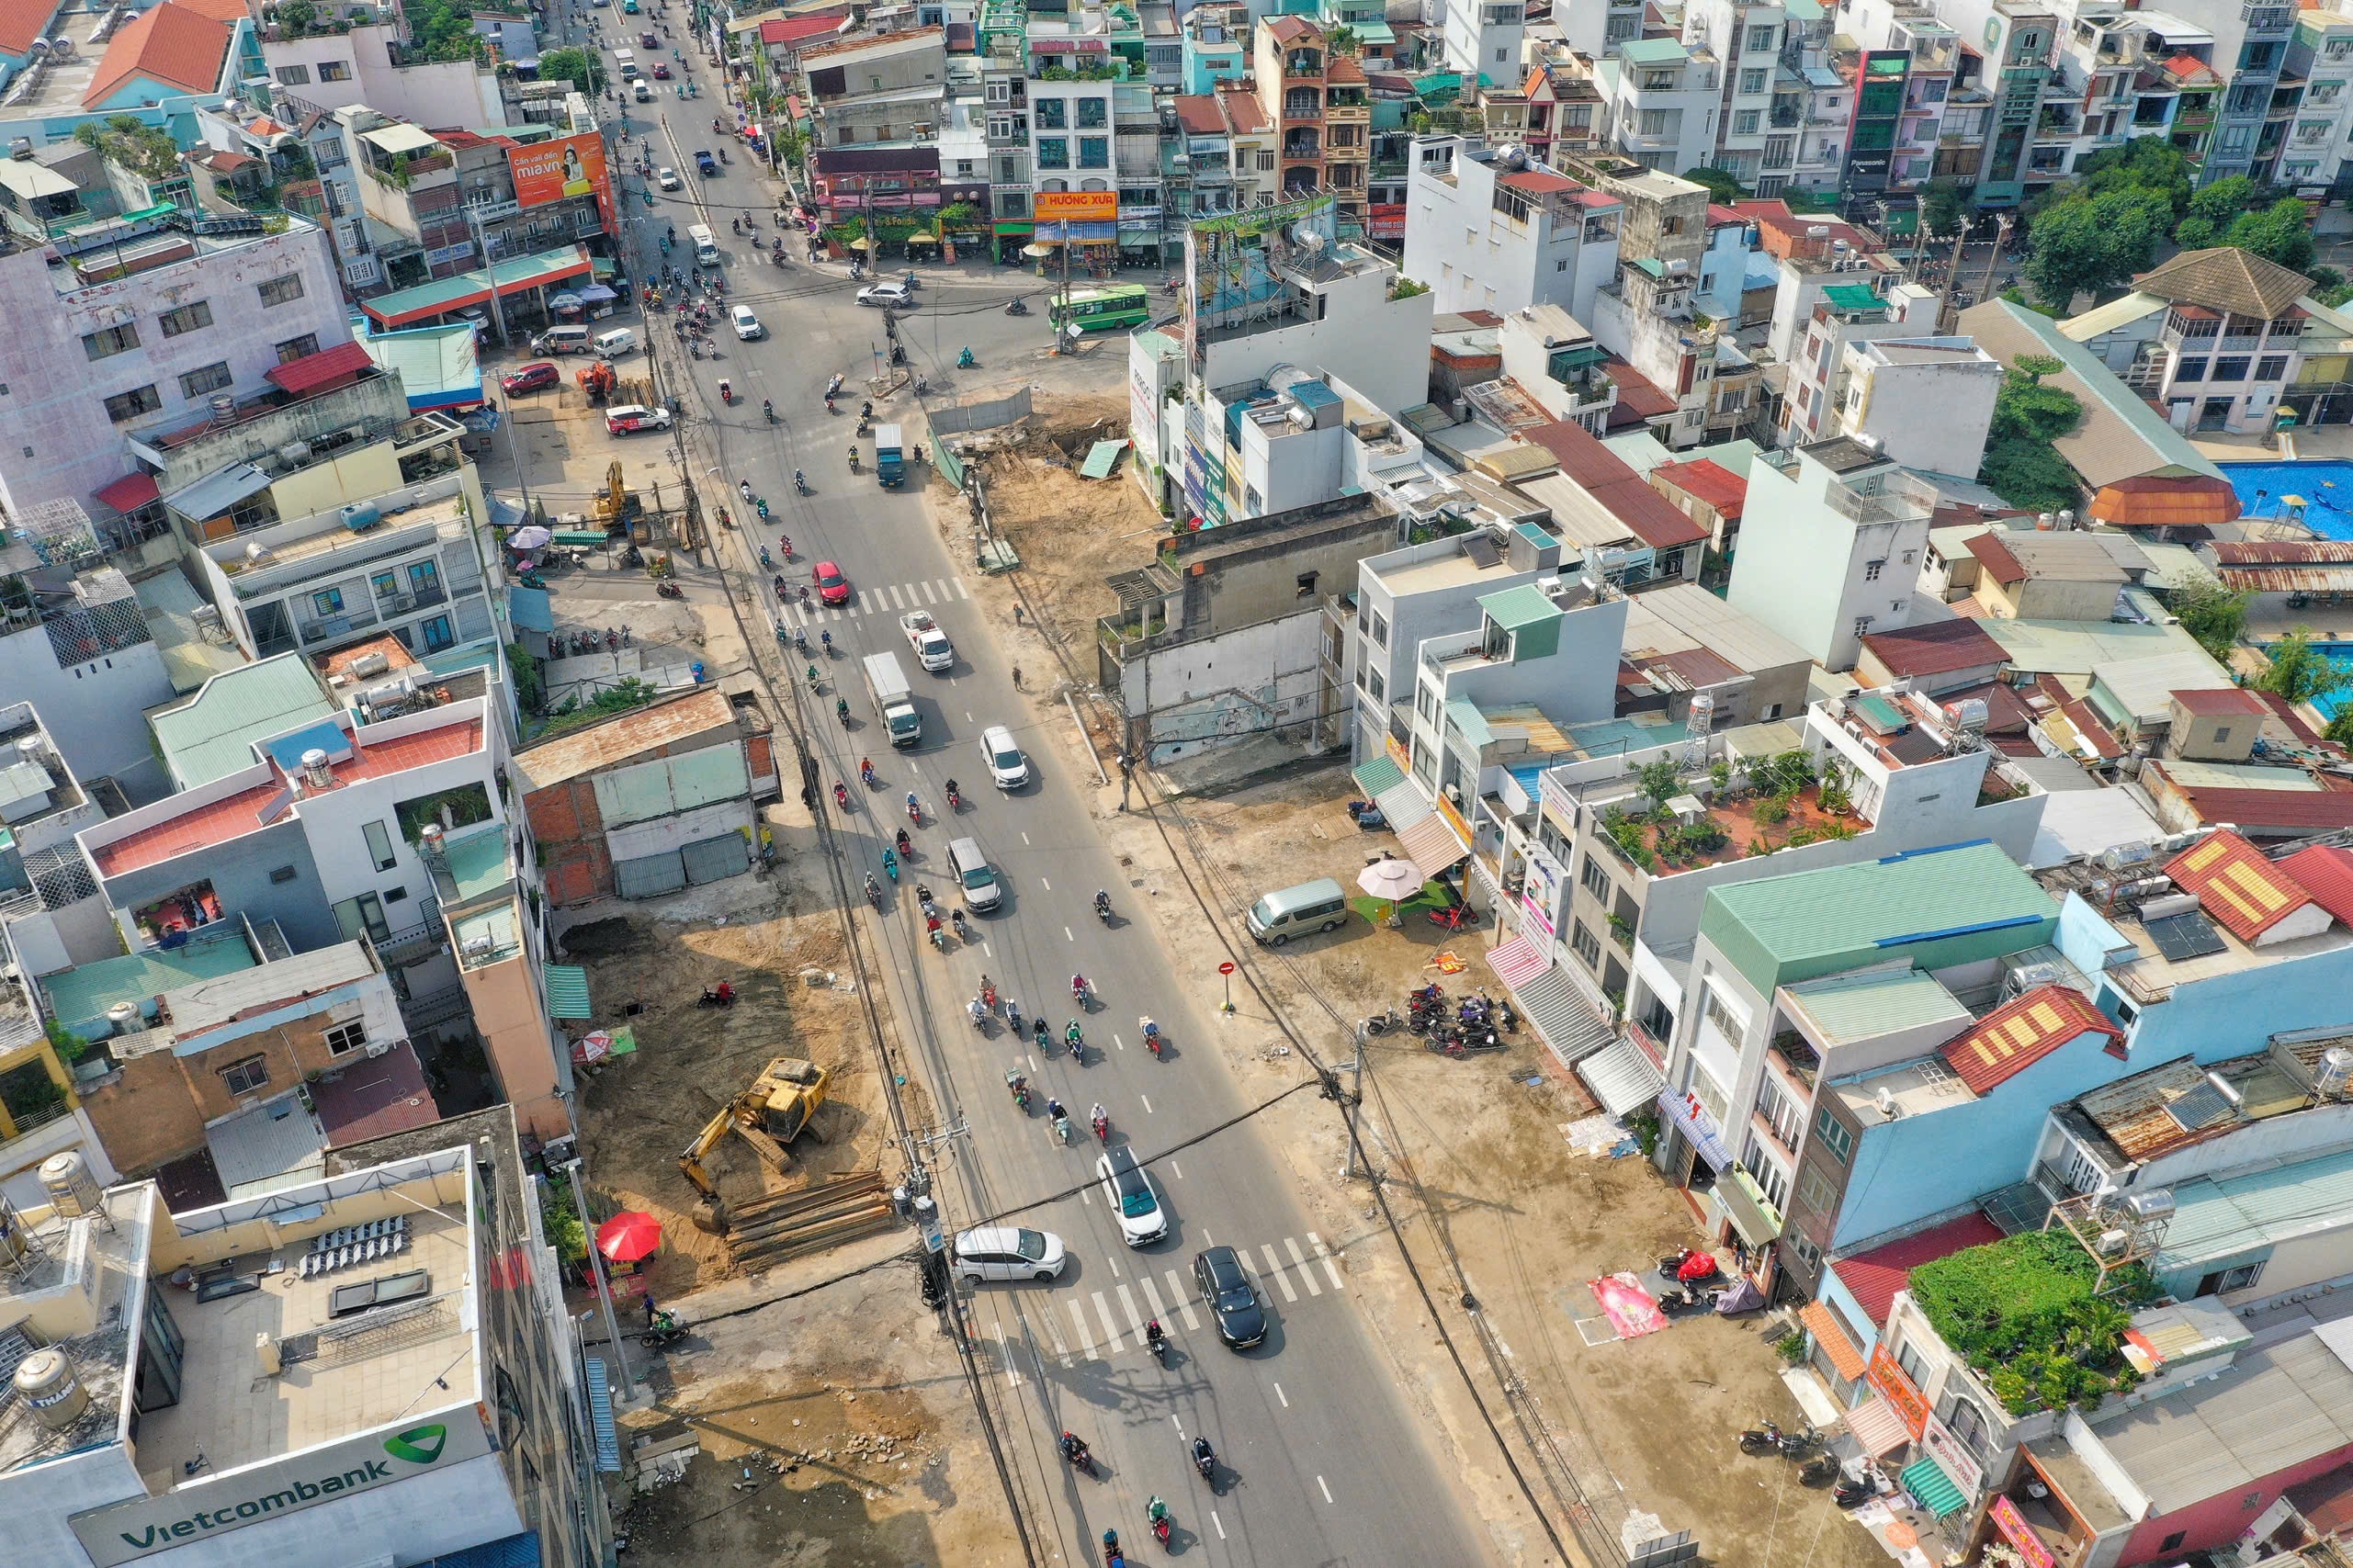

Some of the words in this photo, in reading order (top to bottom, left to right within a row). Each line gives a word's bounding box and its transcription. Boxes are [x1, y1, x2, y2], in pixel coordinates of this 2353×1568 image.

[530, 154, 543, 163] vali
[516, 161, 560, 179] mia.vn
[1049, 194, 1088, 205] HƯƠNG
[1092, 195, 1114, 205] XƯA
[1134, 369, 1150, 400] PERGO
[120, 1460, 393, 1549] Vietcombank
